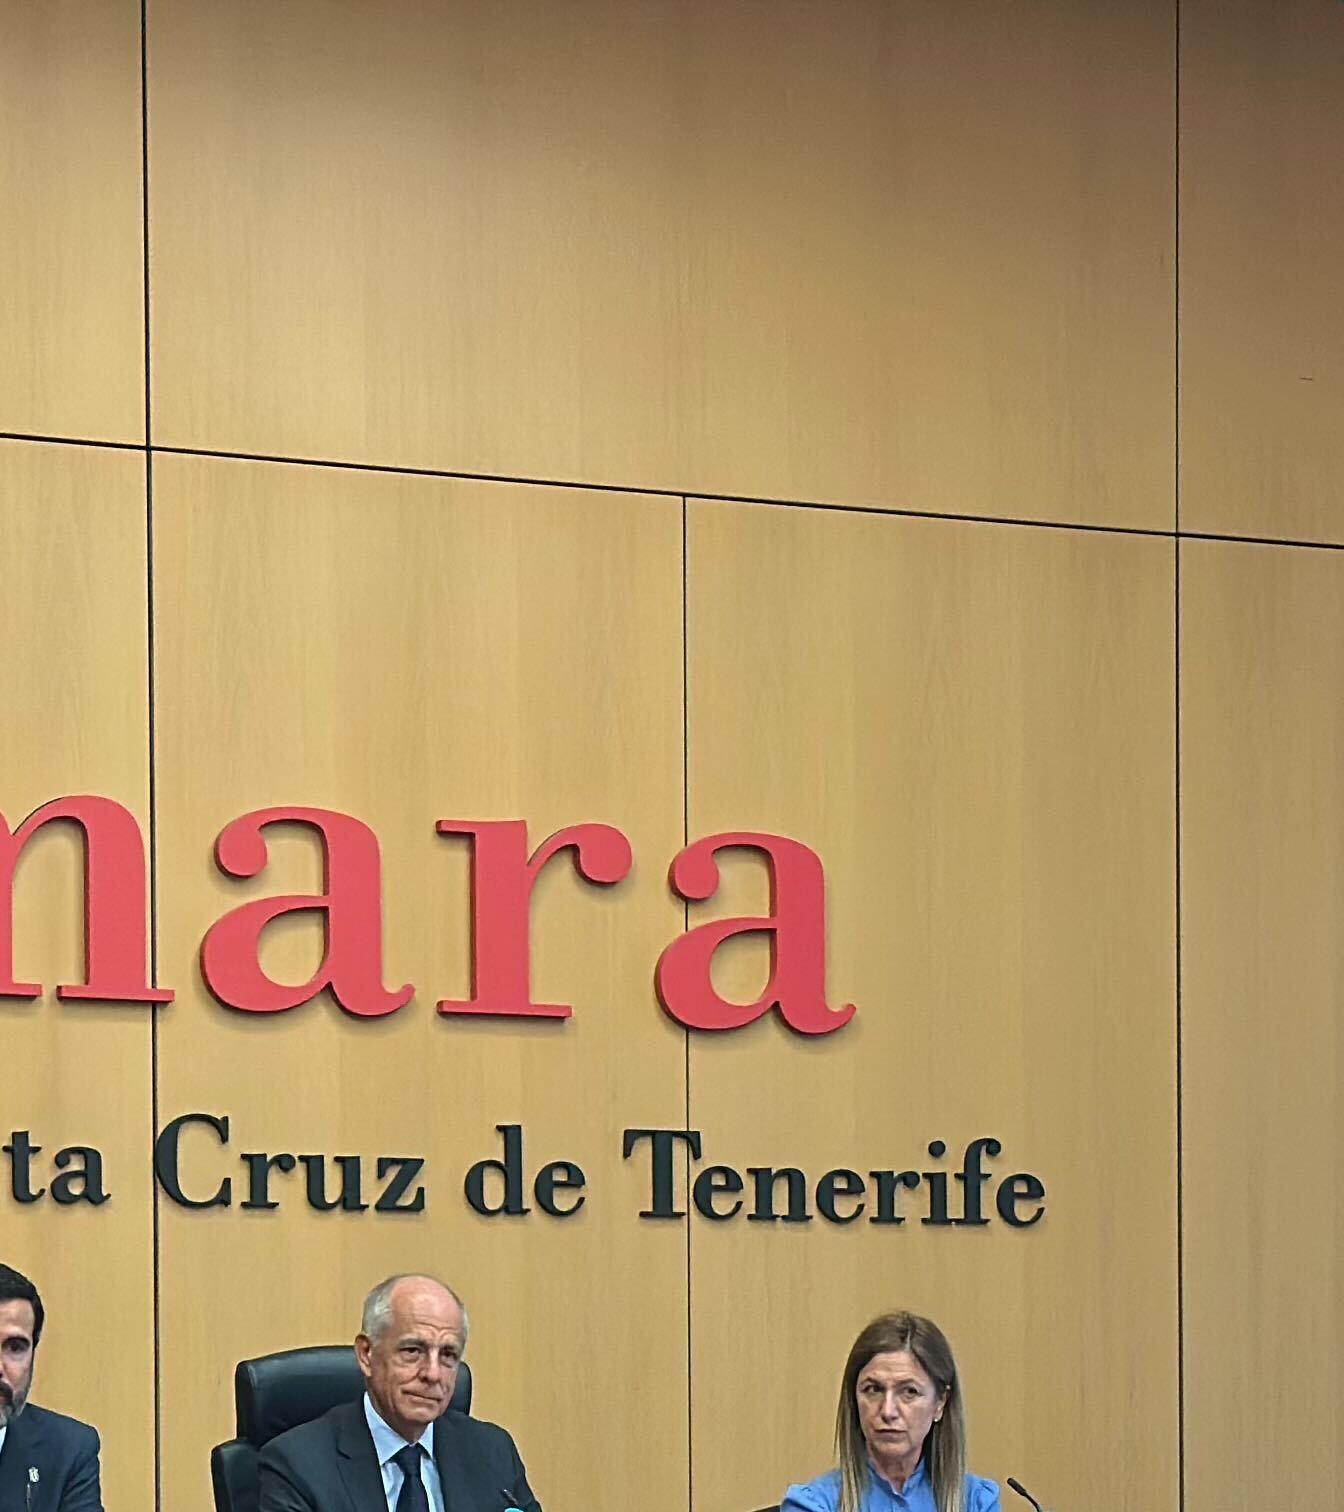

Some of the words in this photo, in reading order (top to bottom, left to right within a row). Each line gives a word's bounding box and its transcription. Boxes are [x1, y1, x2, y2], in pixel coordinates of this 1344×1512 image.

[155, 1112, 426, 1214] Cruz
[464, 1124, 587, 1219] de
[621, 1128, 1046, 1229] Tenerife
